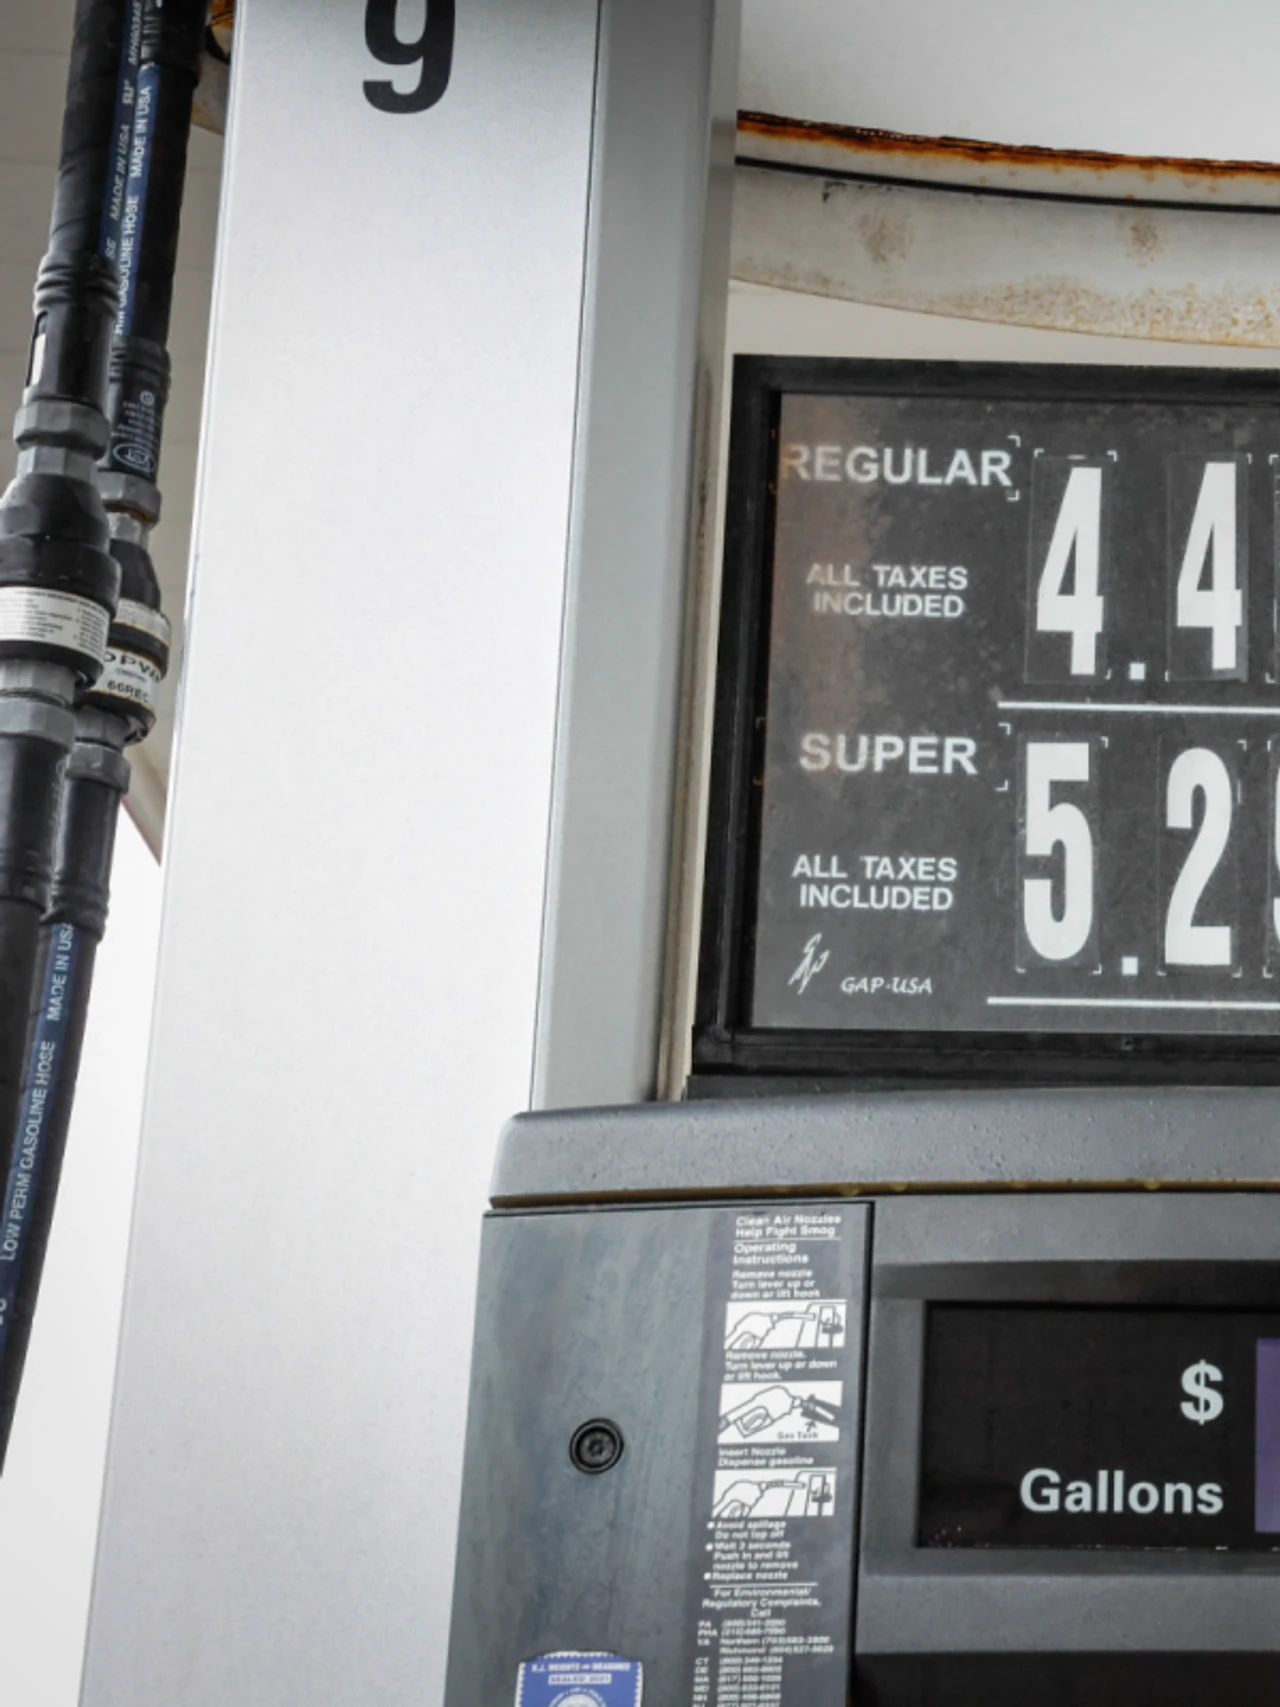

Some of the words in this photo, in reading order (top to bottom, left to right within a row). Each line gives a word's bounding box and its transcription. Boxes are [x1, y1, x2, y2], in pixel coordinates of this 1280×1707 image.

[363, 0, 455, 114] 9
[137, 86, 151, 117] USA
[134, 118, 148, 133] IN
[118, 124, 130, 154] USA
[115, 157, 127, 173] IN
[131, 136, 146, 177] MADE
[109, 175, 125, 220] MADE
[122, 195, 140, 234] HOSE
[781, 445, 1012, 487] REGULAR
[806, 564, 860, 587] ALL
[872, 565, 968, 590] TAXES
[812, 592, 965, 618] INCLUDED
[799, 733, 979, 775] SUPER
[792, 854, 848, 878] ALL
[860, 856, 958, 882] TAXES
[799, 884, 954, 910] INCLUDED
[54, 953, 70, 971] IN
[46, 973, 68, 1021] MADE
[34, 1040, 57, 1085] HOSE
[19, 1085, 48, 1171] GASOLINE
[9, 1172, 31, 1220] PERM
[773, 1214, 792, 1225] Air
[794, 1213, 842, 1225] Nozzles
[735, 1227, 763, 1239] Help
[765, 1226, 798, 1239] Fight
[800, 1225, 836, 1239] Smog
[0, 1223, 21, 1262] LOW
[734, 1242, 798, 1255] Operating
[733, 1254, 809, 1265] Instructions
[732, 1269, 776, 1279] Remove
[777, 1268, 813, 1278] nozzle
[732, 1280, 756, 1289] Turn
[758, 1279, 784, 1289] lever
[787, 1280, 801, 1290] up
[793, 1286, 820, 1298] hook
[725, 1350, 768, 1361] Remove
[725, 1360, 749, 1371] Turn
[750, 1360, 776, 1370] lever
[778, 1360, 793, 1372] up
[808, 1358, 838, 1369] down
[1180, 1359, 1224, 1426] $
[718, 1446, 749, 1457] Insert
[750, 1446, 787, 1457] Nozzle
[717, 1457, 767, 1468] Dispense
[768, 1456, 815, 1467] gasoline
[1019, 1467, 1224, 1516] Gallons
[747, 1519, 787, 1531] spillage
[748, 1540, 791, 1550] seconds
[713, 1551, 740, 1561] Push
[712, 1562, 746, 1572] nozzle
[760, 1561, 800, 1570] remove
[712, 1571, 753, 1582] Replace
[755, 1570, 789, 1580] nozzle
[714, 1587, 731, 1597] For
[702, 1598, 758, 1610] Regulatory
